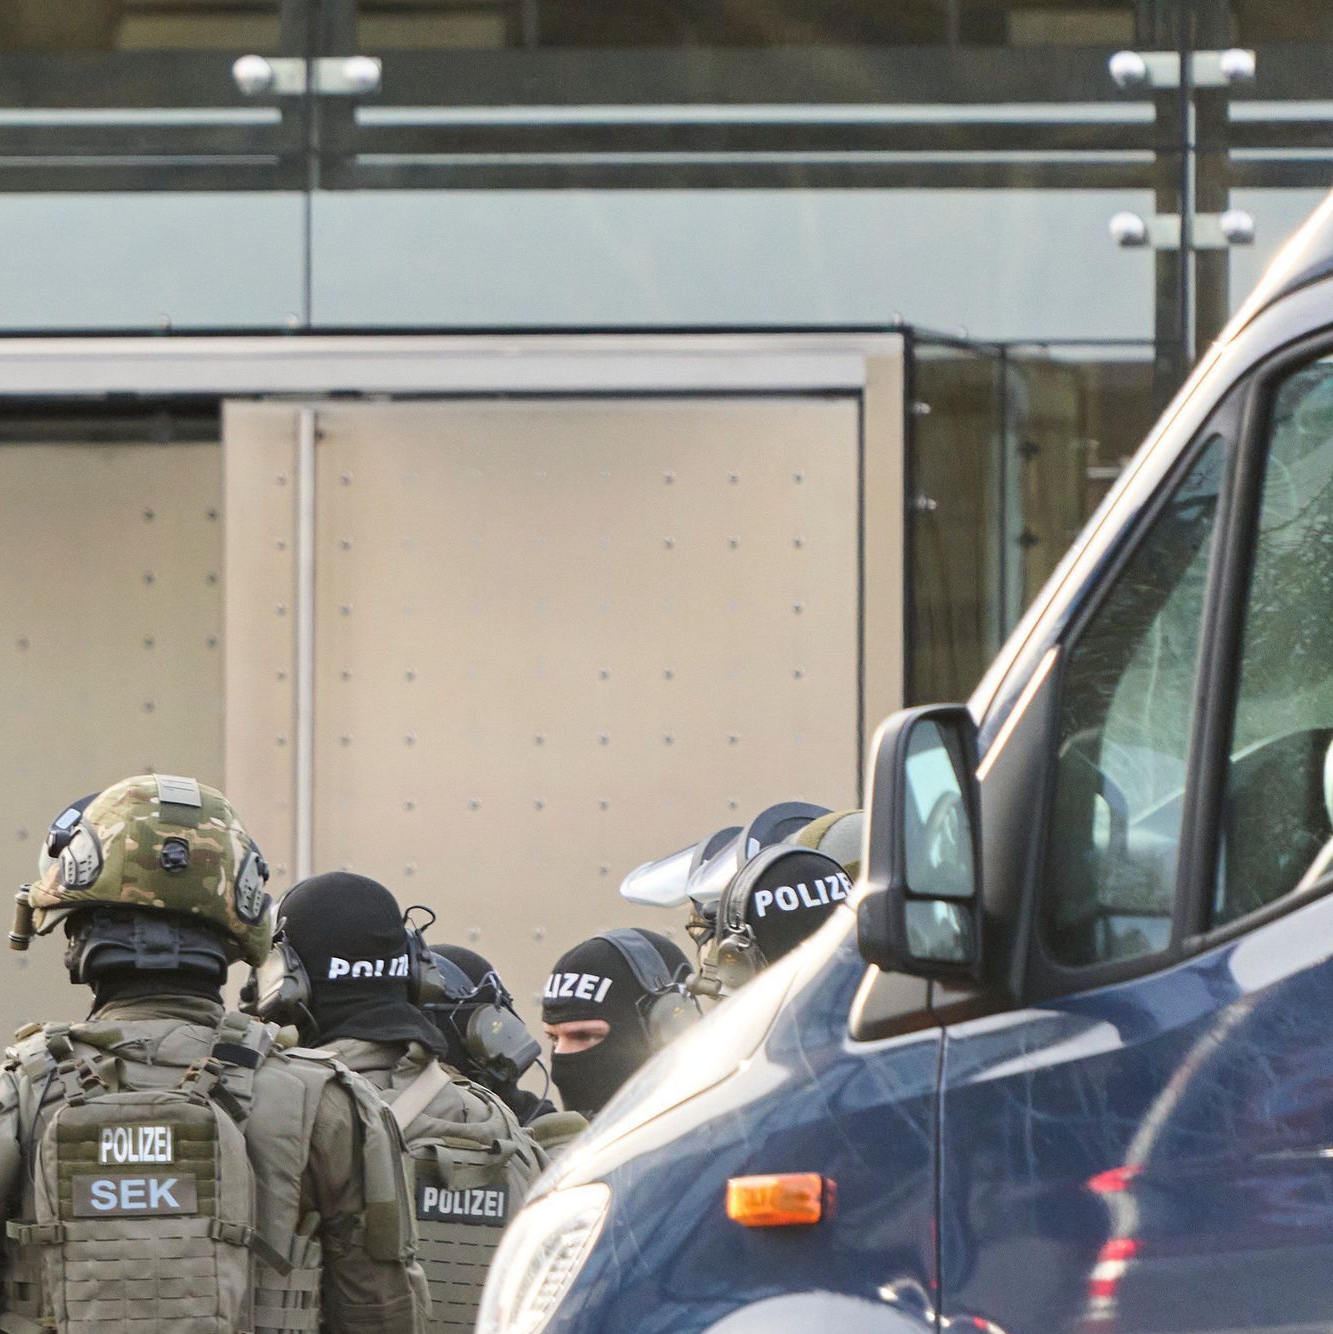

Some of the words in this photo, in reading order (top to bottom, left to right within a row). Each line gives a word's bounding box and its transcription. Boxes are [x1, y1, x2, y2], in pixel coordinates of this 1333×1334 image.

[101, 1126, 172, 1163] POLIZEI
[90, 1178, 180, 1211] SEK
[423, 1186, 504, 1217] POLIZEI
